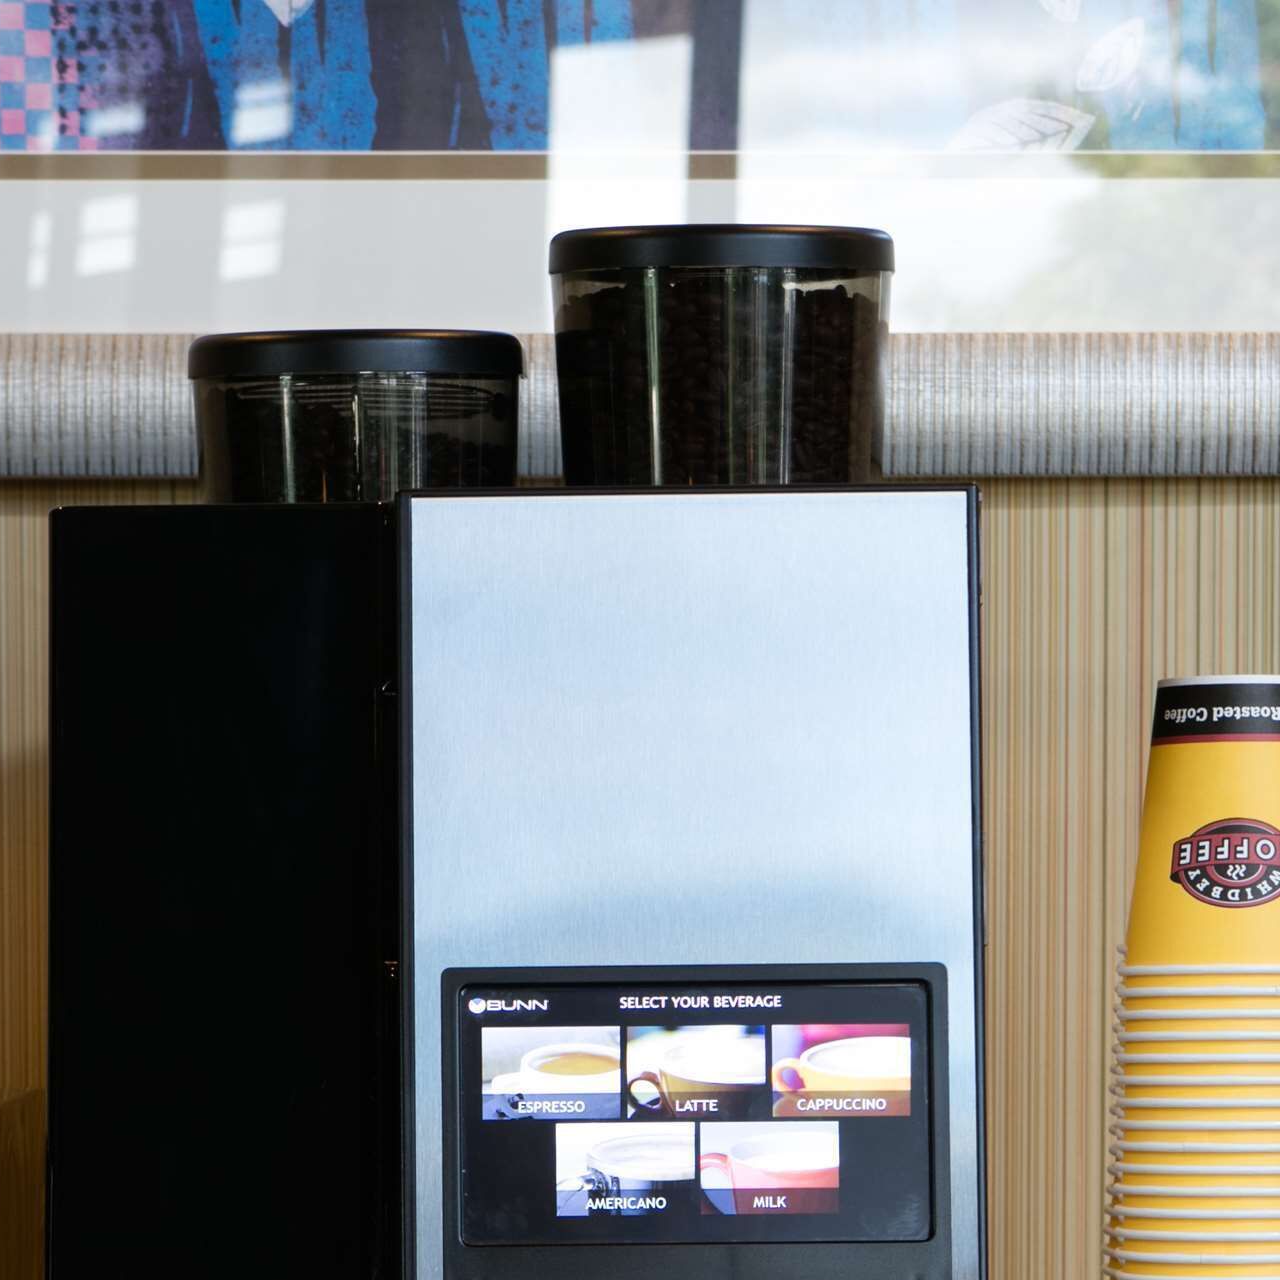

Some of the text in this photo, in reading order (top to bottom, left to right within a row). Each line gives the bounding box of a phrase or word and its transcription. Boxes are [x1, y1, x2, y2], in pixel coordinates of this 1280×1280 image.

[1164, 706, 1208, 723] Coffee
[486, 999, 548, 1012] BUNN
[619, 995, 782, 1009] SELECT YOUR BEVERAGE
[517, 1101, 585, 1113] ESPRESSO
[675, 1099, 718, 1112] LATTE
[796, 1098, 887, 1111] CAPPUCCINO
[585, 1197, 667, 1210] AMERICANO
[753, 1196, 787, 1208] MILK
